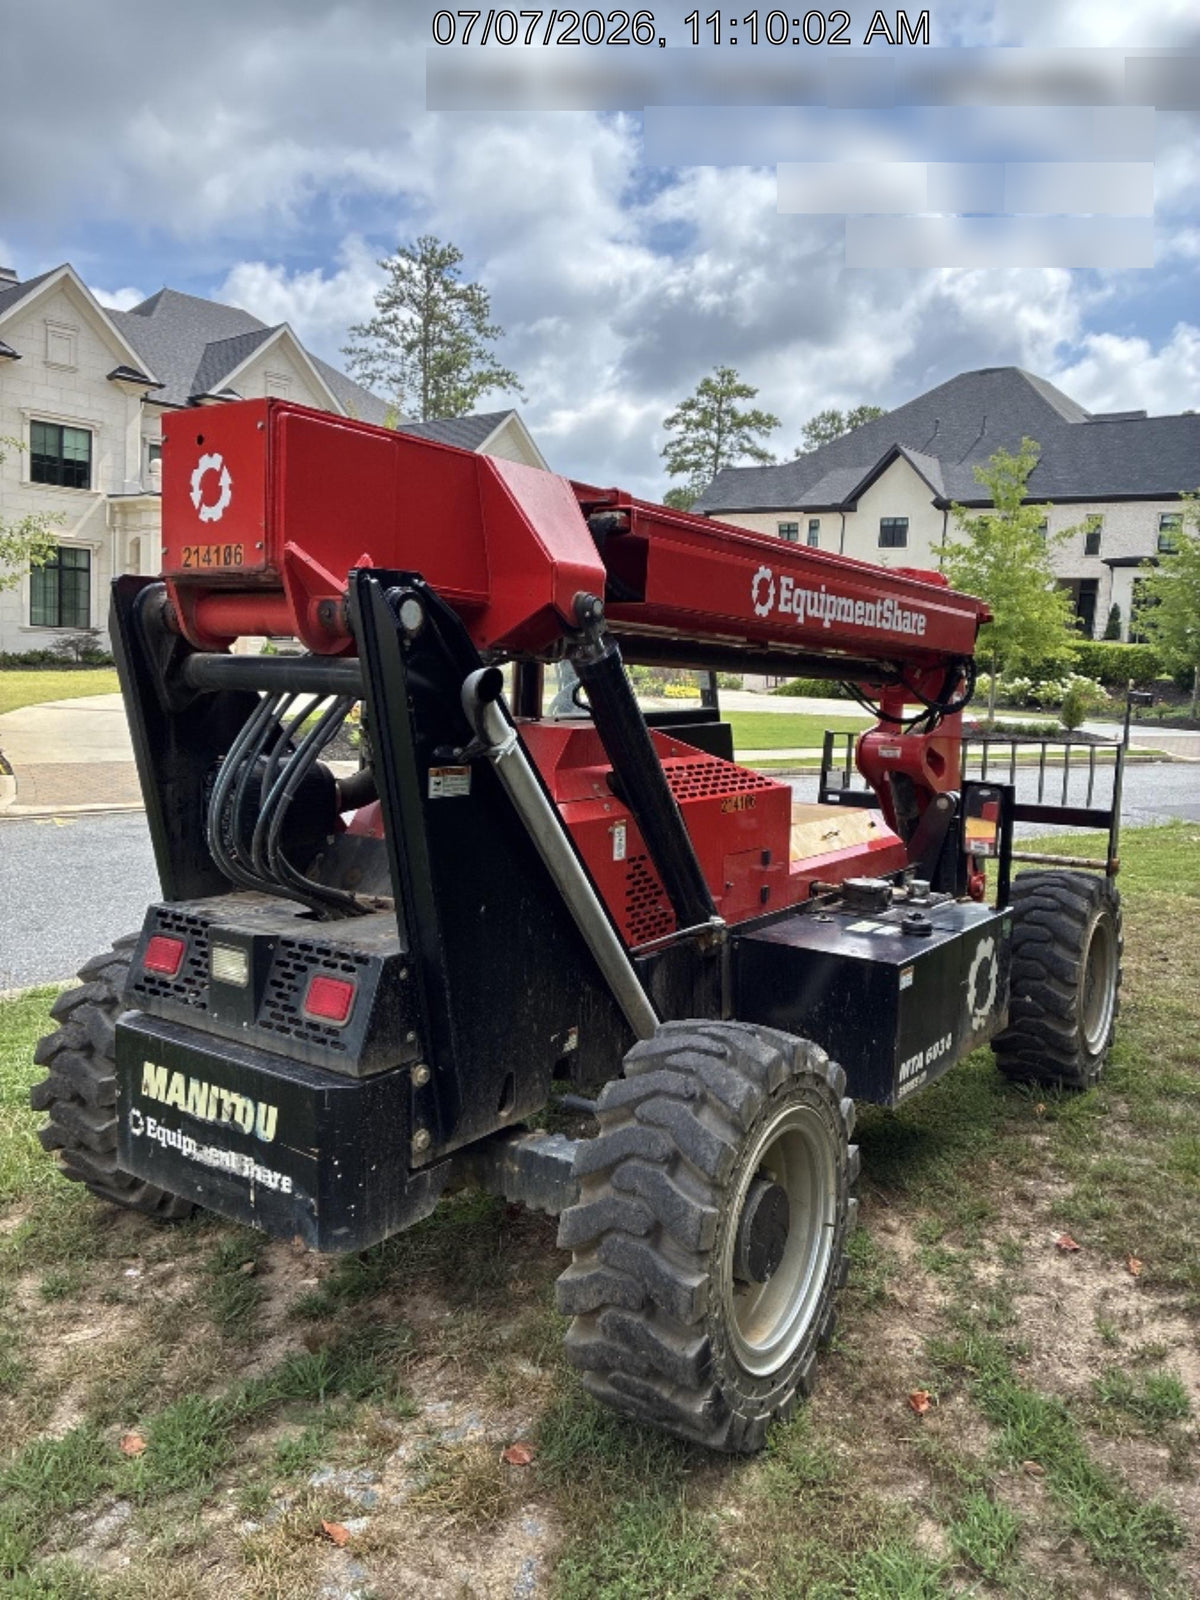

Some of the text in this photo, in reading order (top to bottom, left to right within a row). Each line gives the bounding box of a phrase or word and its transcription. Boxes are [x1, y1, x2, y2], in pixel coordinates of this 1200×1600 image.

[183, 545, 243, 568] 214106
[778, 575, 927, 636] EquipmentShare
[141, 1060, 279, 1142] MANITOU
